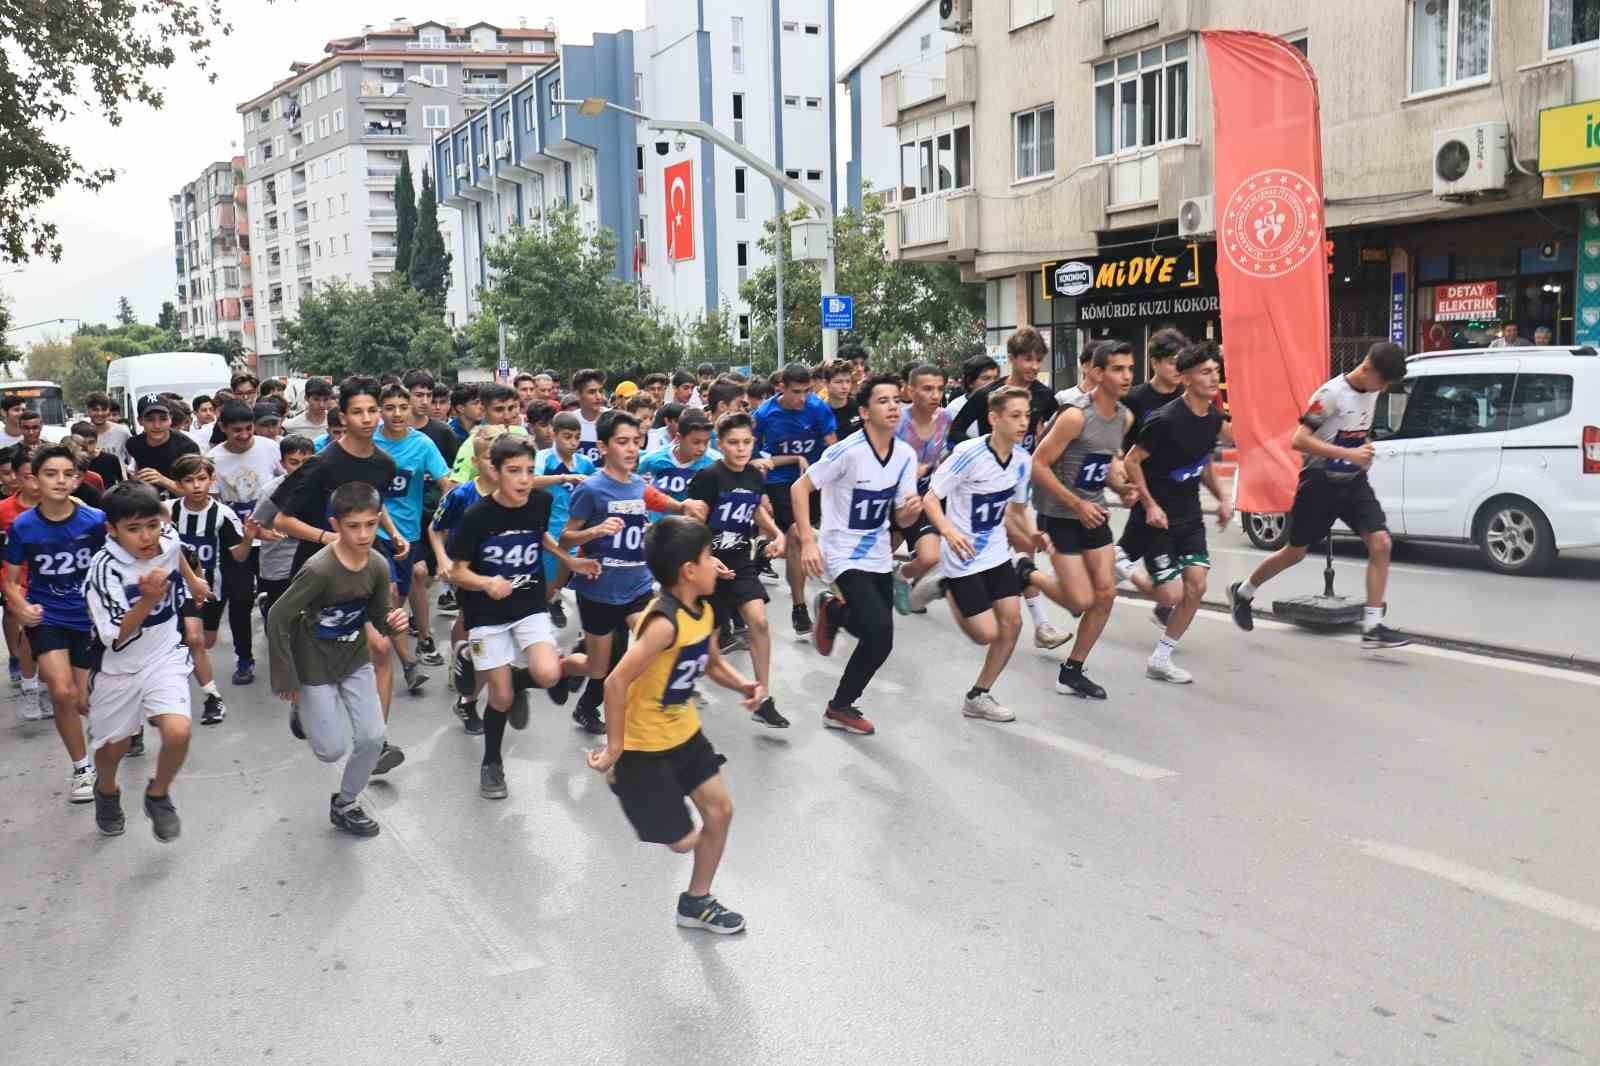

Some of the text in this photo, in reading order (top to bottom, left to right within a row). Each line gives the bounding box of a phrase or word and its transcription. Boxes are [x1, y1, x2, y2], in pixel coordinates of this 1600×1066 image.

[1447, 284, 1486, 298] DETAY
[1081, 302, 1137, 320] KÖMÜRDE
[1138, 299, 1172, 316] KUZU
[1438, 296, 1495, 313] ELEKTRİK
[657, 476, 693, 492] 10
[612, 525, 646, 550] 10
[34, 547, 93, 576] 228
[483, 542, 540, 568] 246
